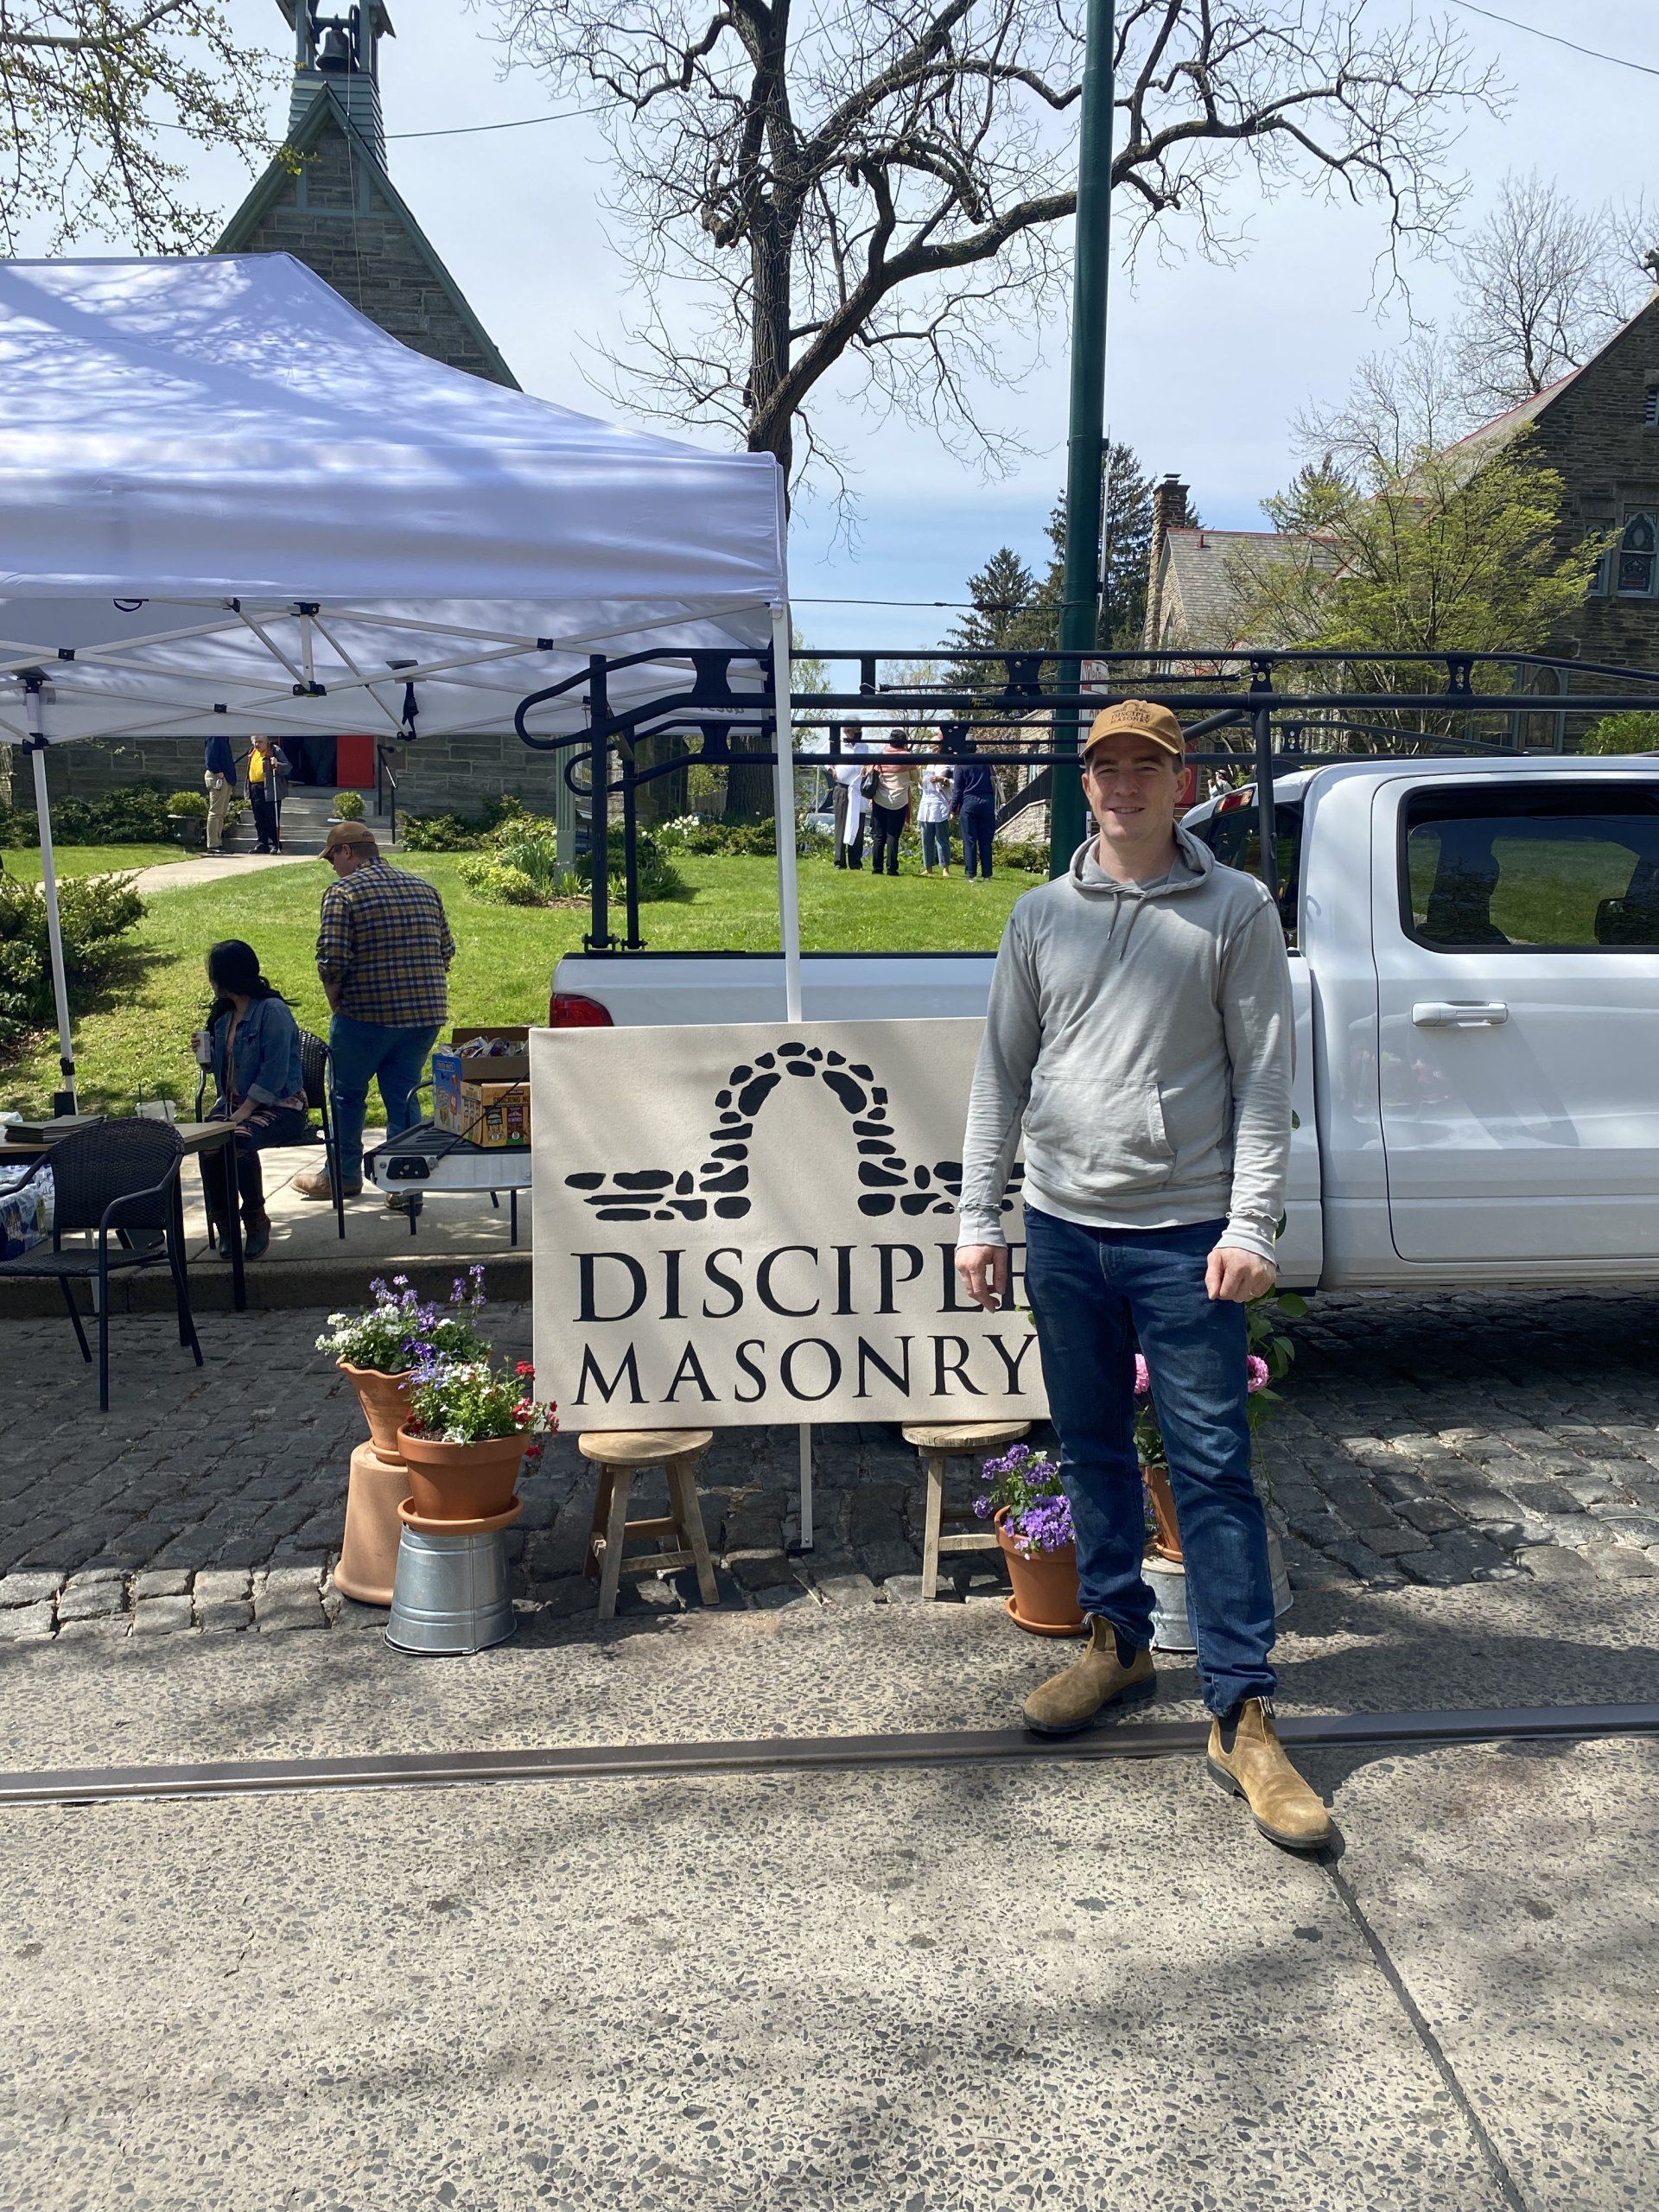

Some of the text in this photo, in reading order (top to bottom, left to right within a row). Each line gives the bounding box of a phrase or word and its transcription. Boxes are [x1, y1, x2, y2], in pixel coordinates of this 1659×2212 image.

[1111, 710, 1151, 719] DISCIPLE
[570, 1243, 1032, 1323] DISCIPLE
[570, 1334, 1039, 1406] MASONRY
